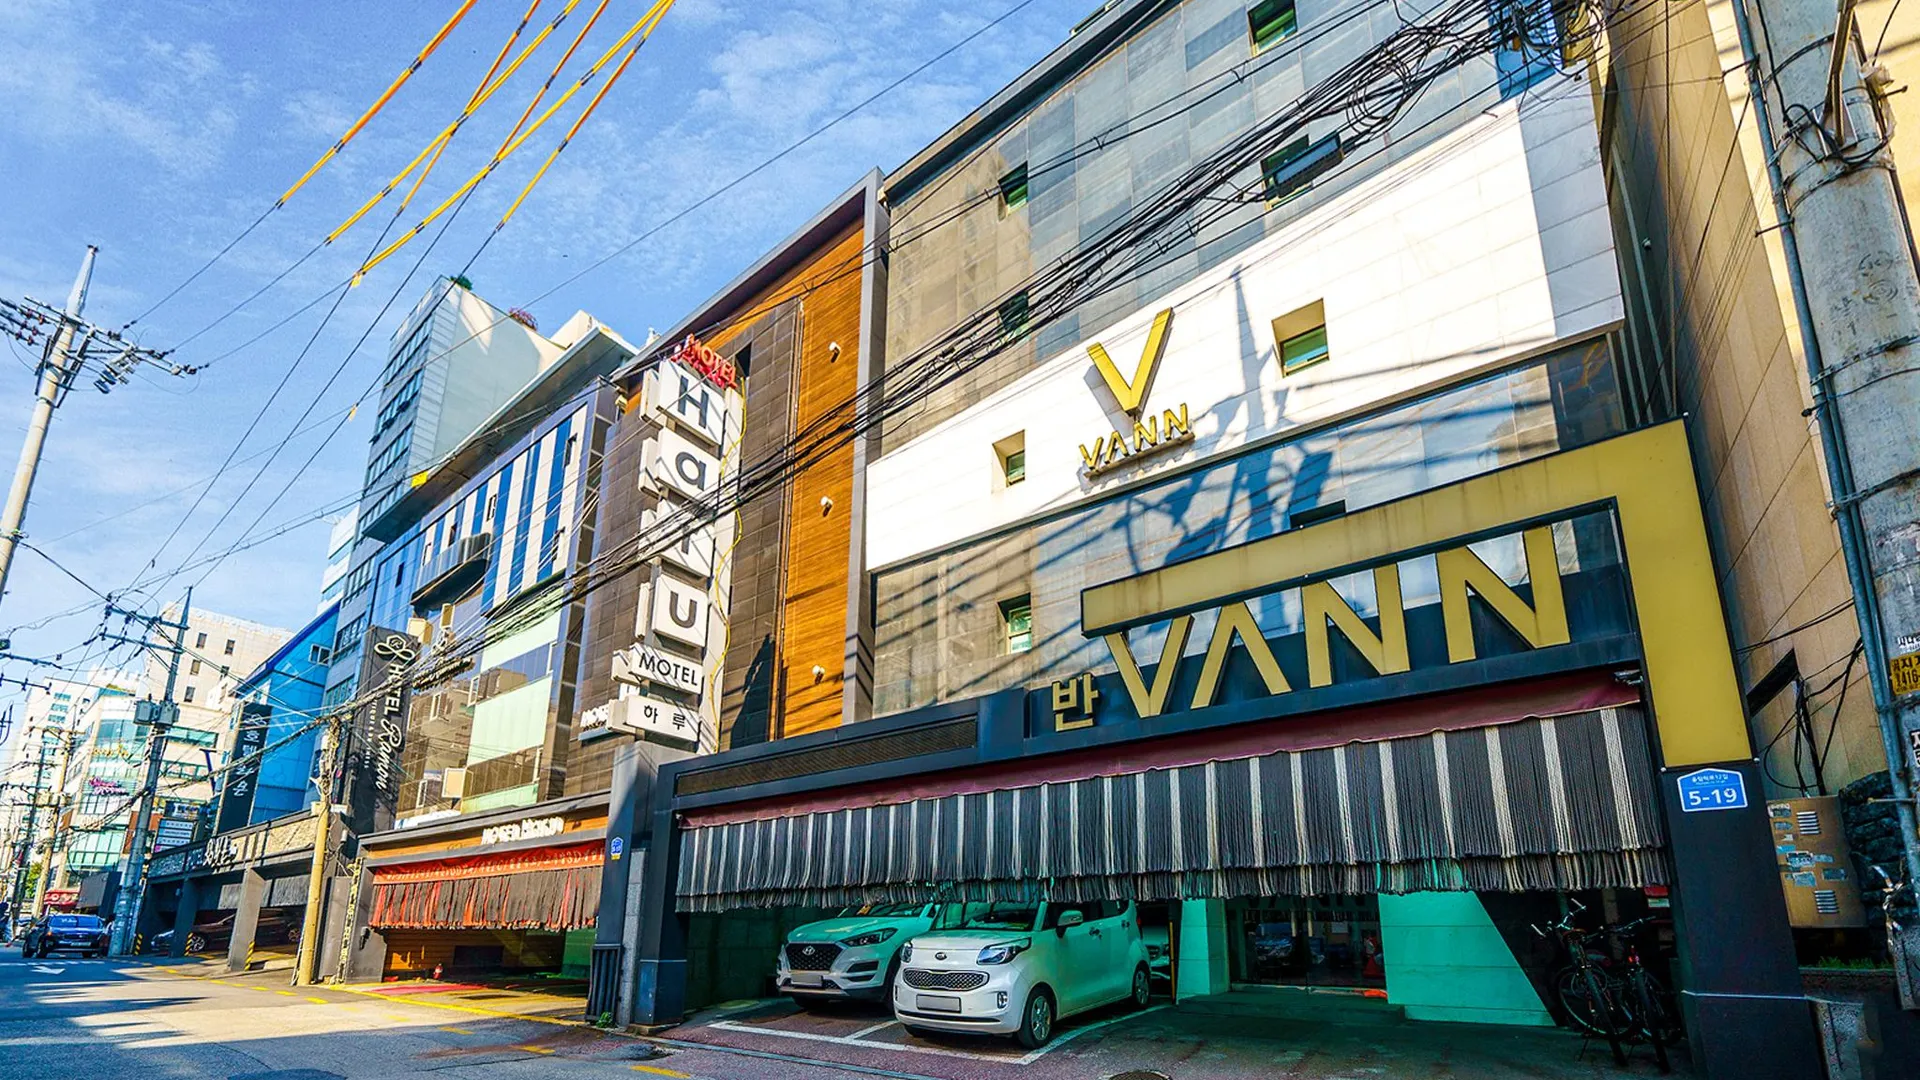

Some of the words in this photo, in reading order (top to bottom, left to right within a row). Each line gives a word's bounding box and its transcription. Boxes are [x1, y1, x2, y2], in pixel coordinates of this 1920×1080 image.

[1085, 306, 1175, 416] V
[1078, 403, 1191, 473] VANN
[1051, 672, 1099, 733] 반
[1103, 523, 1572, 720] VANN
[638, 651, 699, 688] MOTEL
[375, 717, 402, 790] Ramon
[1688, 787, 1738, 806] 5-19
